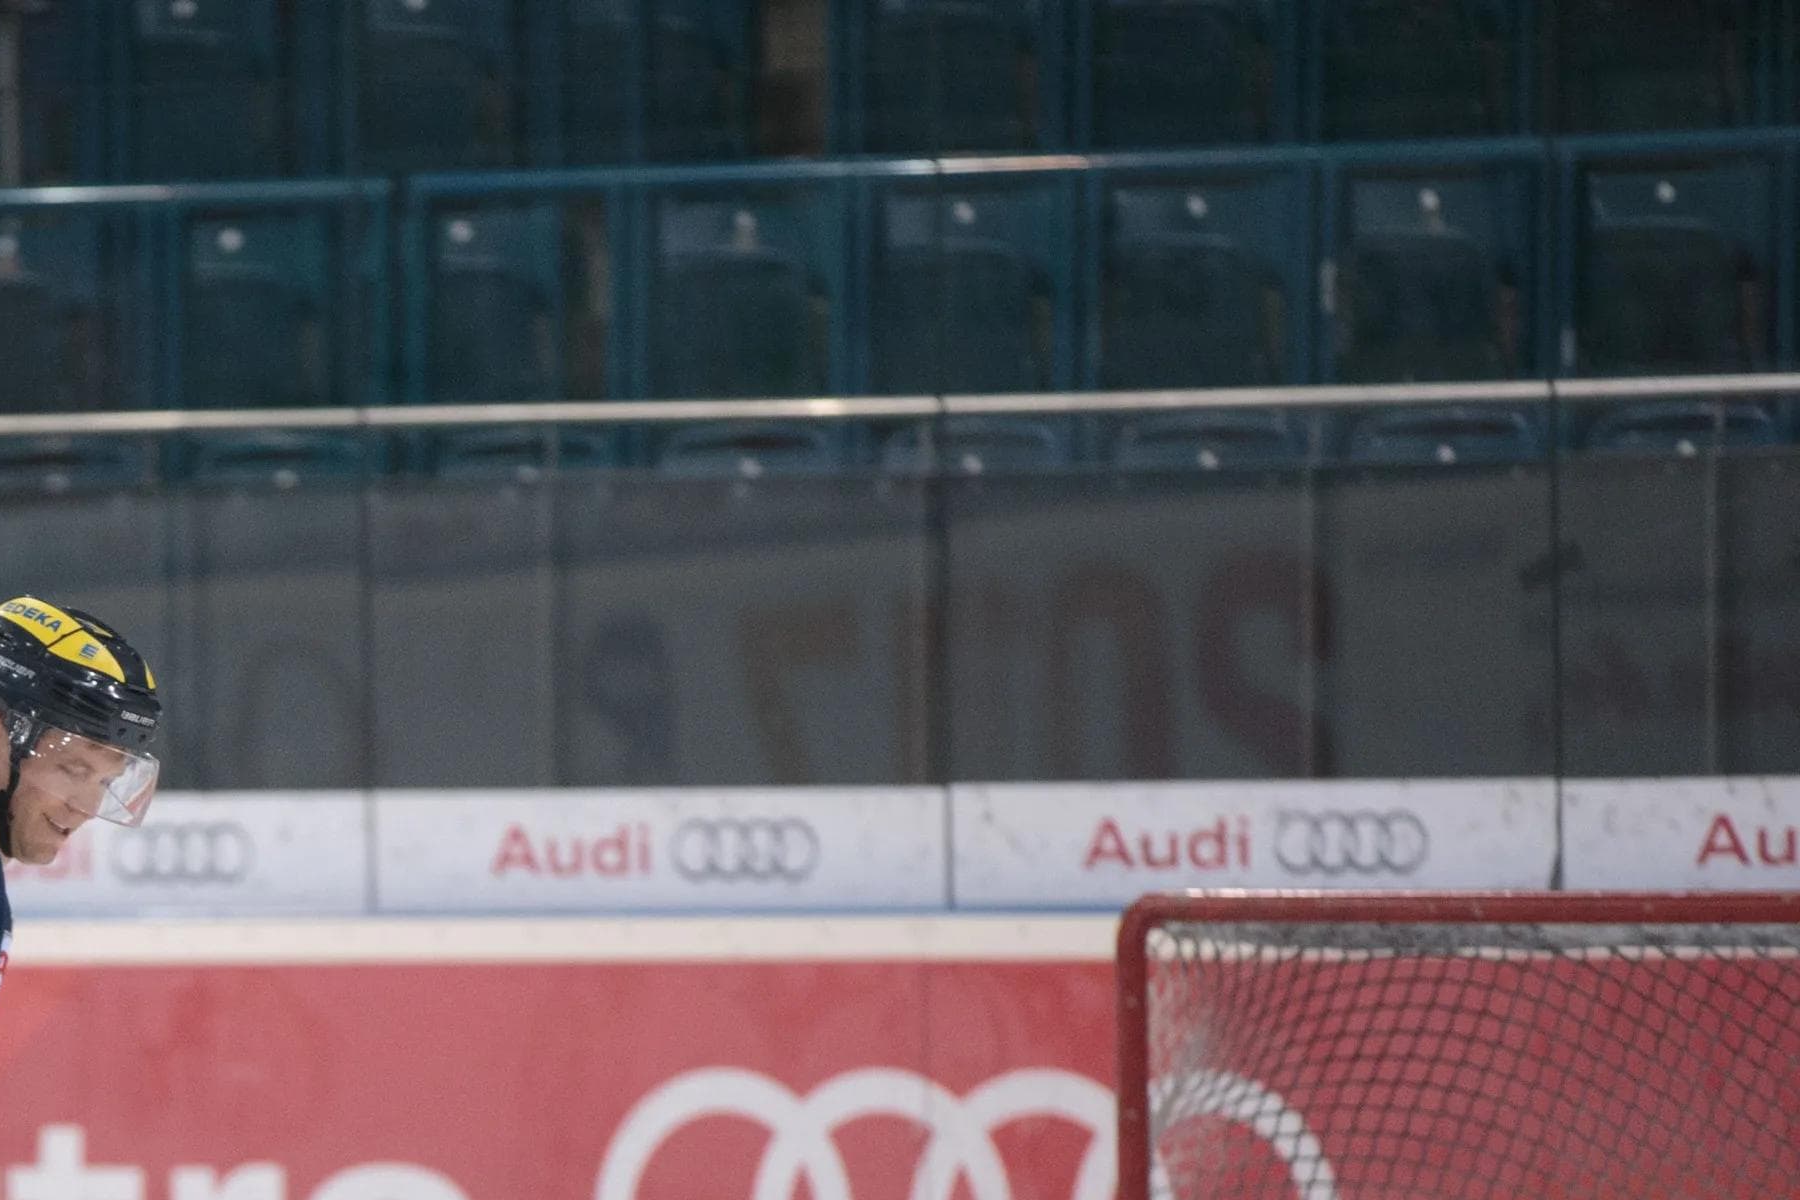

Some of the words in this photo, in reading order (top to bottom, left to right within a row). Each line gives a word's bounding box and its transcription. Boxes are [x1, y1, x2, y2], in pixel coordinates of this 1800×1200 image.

[2, 602, 63, 633] EDEKA
[489, 821, 654, 879] Audi
[1084, 816, 1251, 873] Audi
